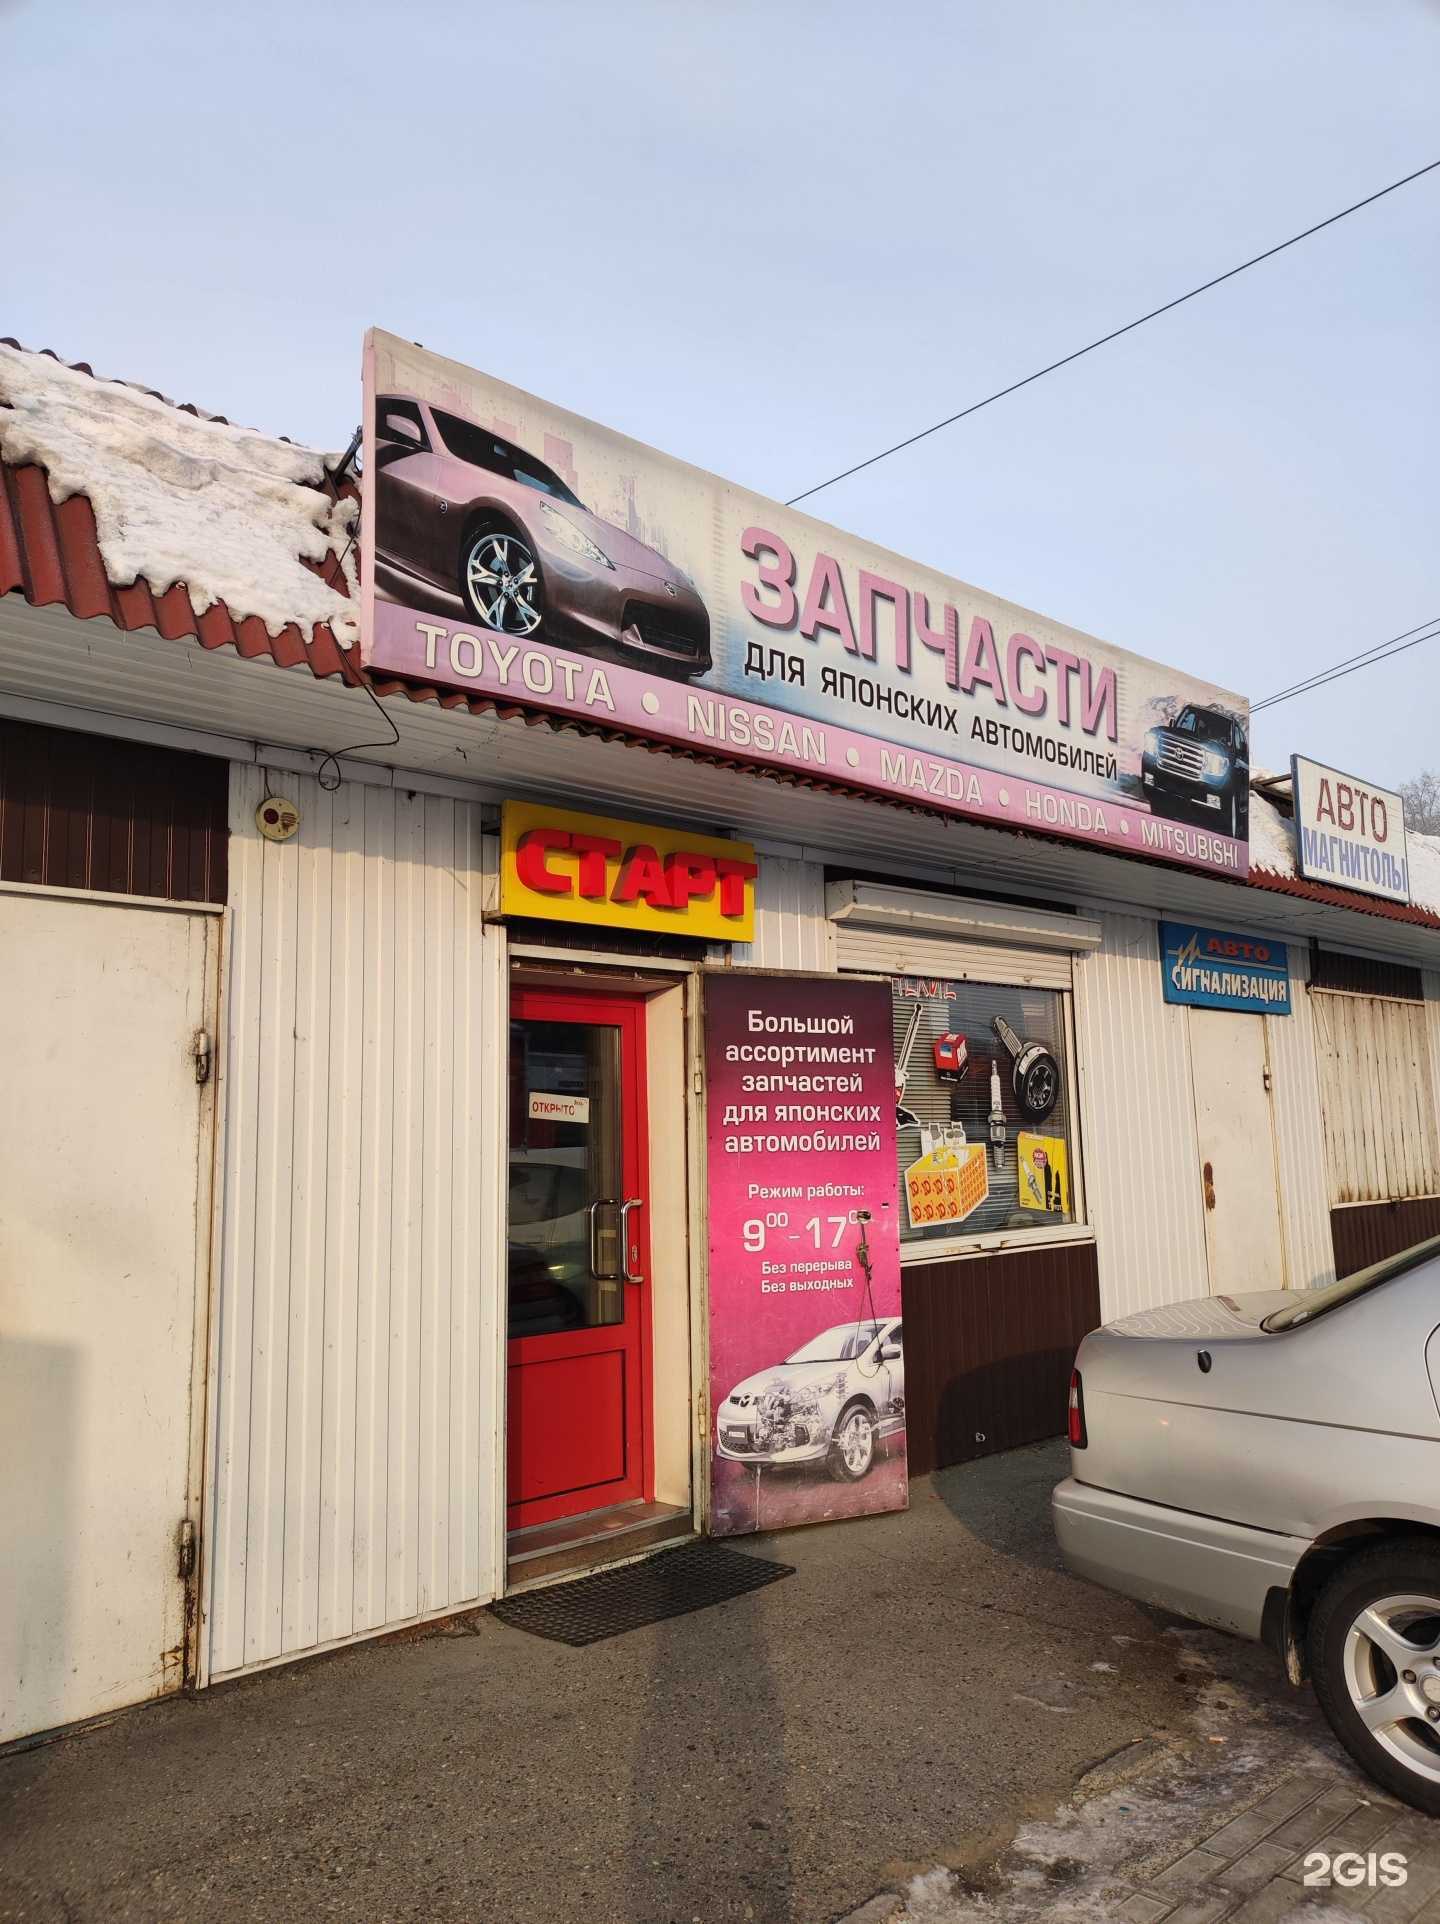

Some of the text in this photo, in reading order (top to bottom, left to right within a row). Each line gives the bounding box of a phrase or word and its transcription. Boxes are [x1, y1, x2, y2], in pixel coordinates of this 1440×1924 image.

[741, 526, 1119, 742] ЗАПЧАСТИ
[744, 641, 1119, 782] ДЛЯ ЯПОНСКИХ АВТОМОБИЛЕЙ
[416, 622, 1239, 869] TOYOTA NISSAN MAZDA HONDA MITSUBISHI
[1316, 778, 1388, 843] АВТО
[1302, 826, 1408, 893] МАГНИТОЛЫ
[515, 828, 758, 917] СТАРТ
[1207, 937, 1270, 962] АВТО
[1171, 965, 1288, 1004] СИГНАЛИЗАЦИЯ
[747, 1009, 854, 1035] Большой
[725, 1043, 876, 1068] ассортимент
[742, 1072, 863, 1093] запчастей
[723, 1104, 881, 1127] для японских
[724, 1129, 881, 1153] автомобилей
[748, 1183, 865, 1201] Режим работы:
[762, 1260, 853, 1275] Без перерыва
[761, 1278, 854, 1293] Без выходных
